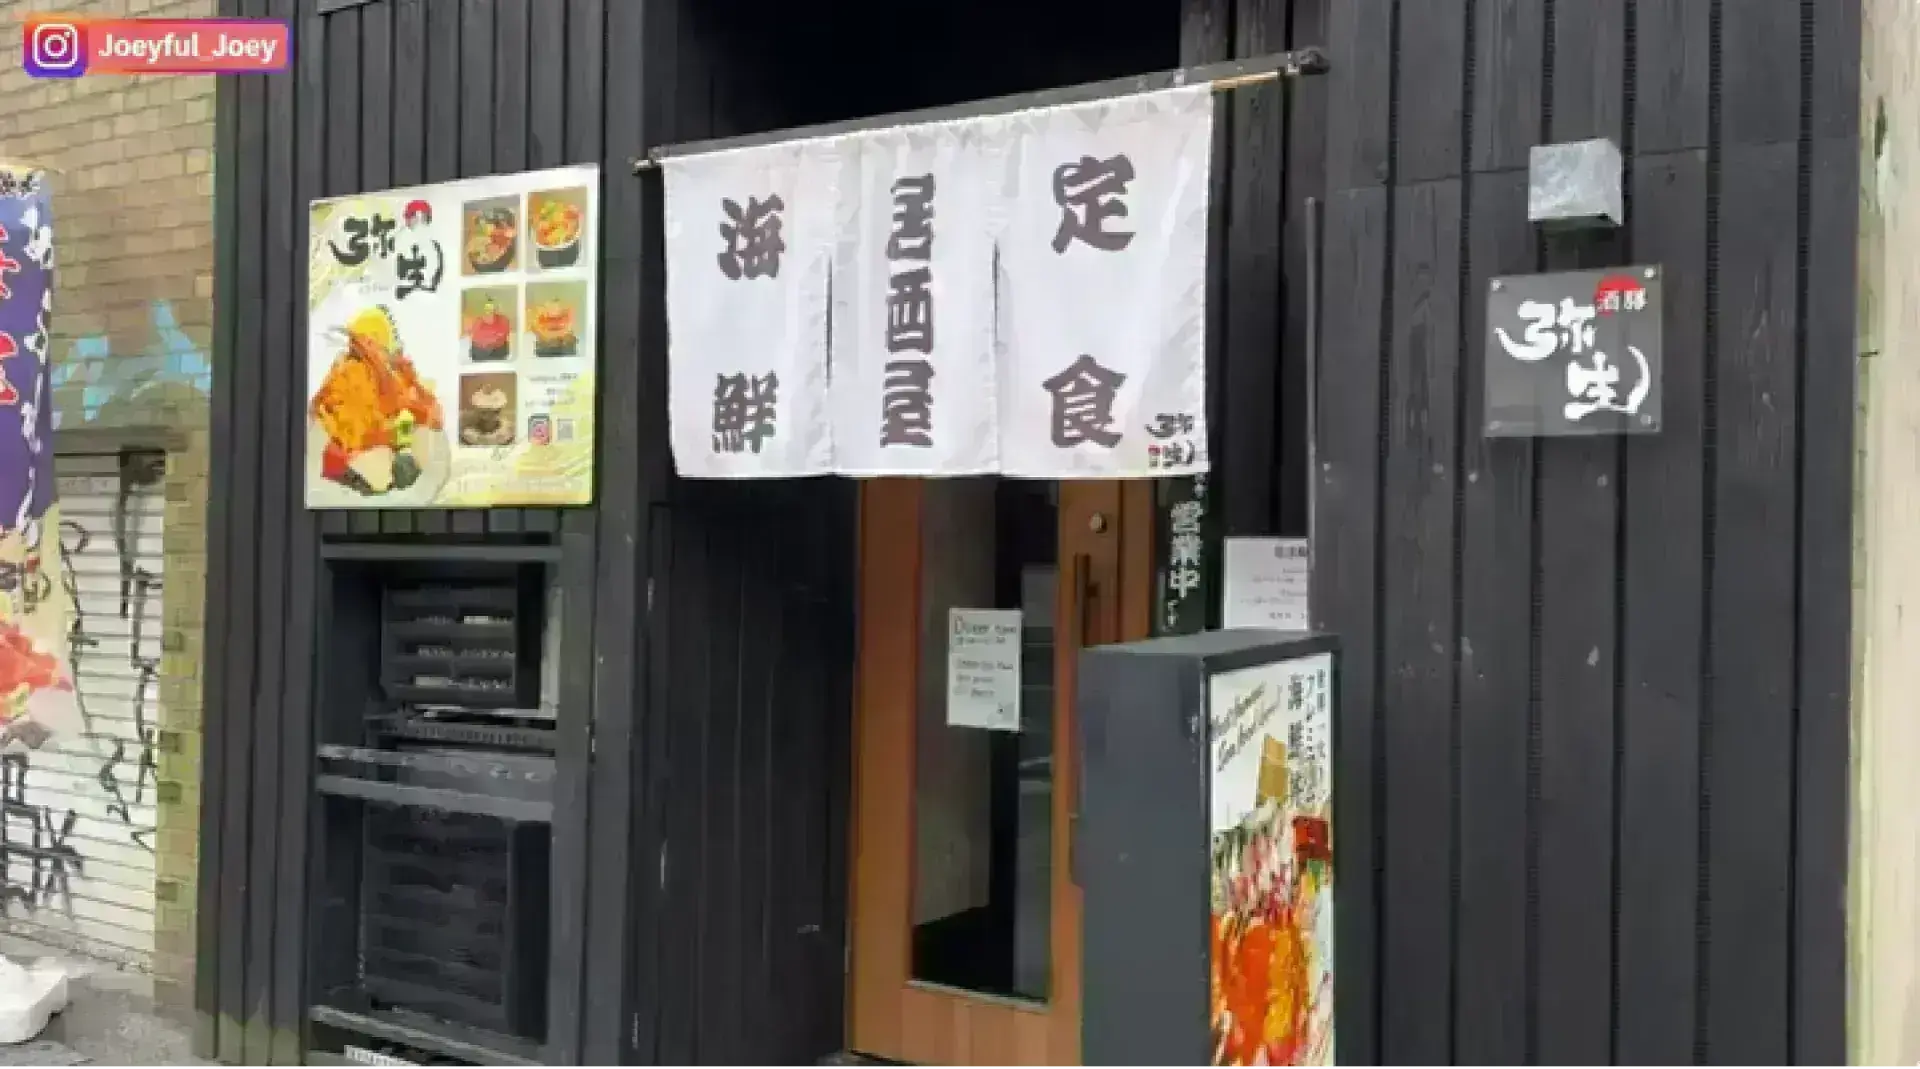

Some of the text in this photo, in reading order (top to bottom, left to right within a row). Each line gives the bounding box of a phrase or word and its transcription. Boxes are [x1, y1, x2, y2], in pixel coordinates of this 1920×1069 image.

[712, 193, 786, 454] 海鮮
[1043, 153, 1136, 449] 定食
[1169, 500, 1204, 598] 営業中
